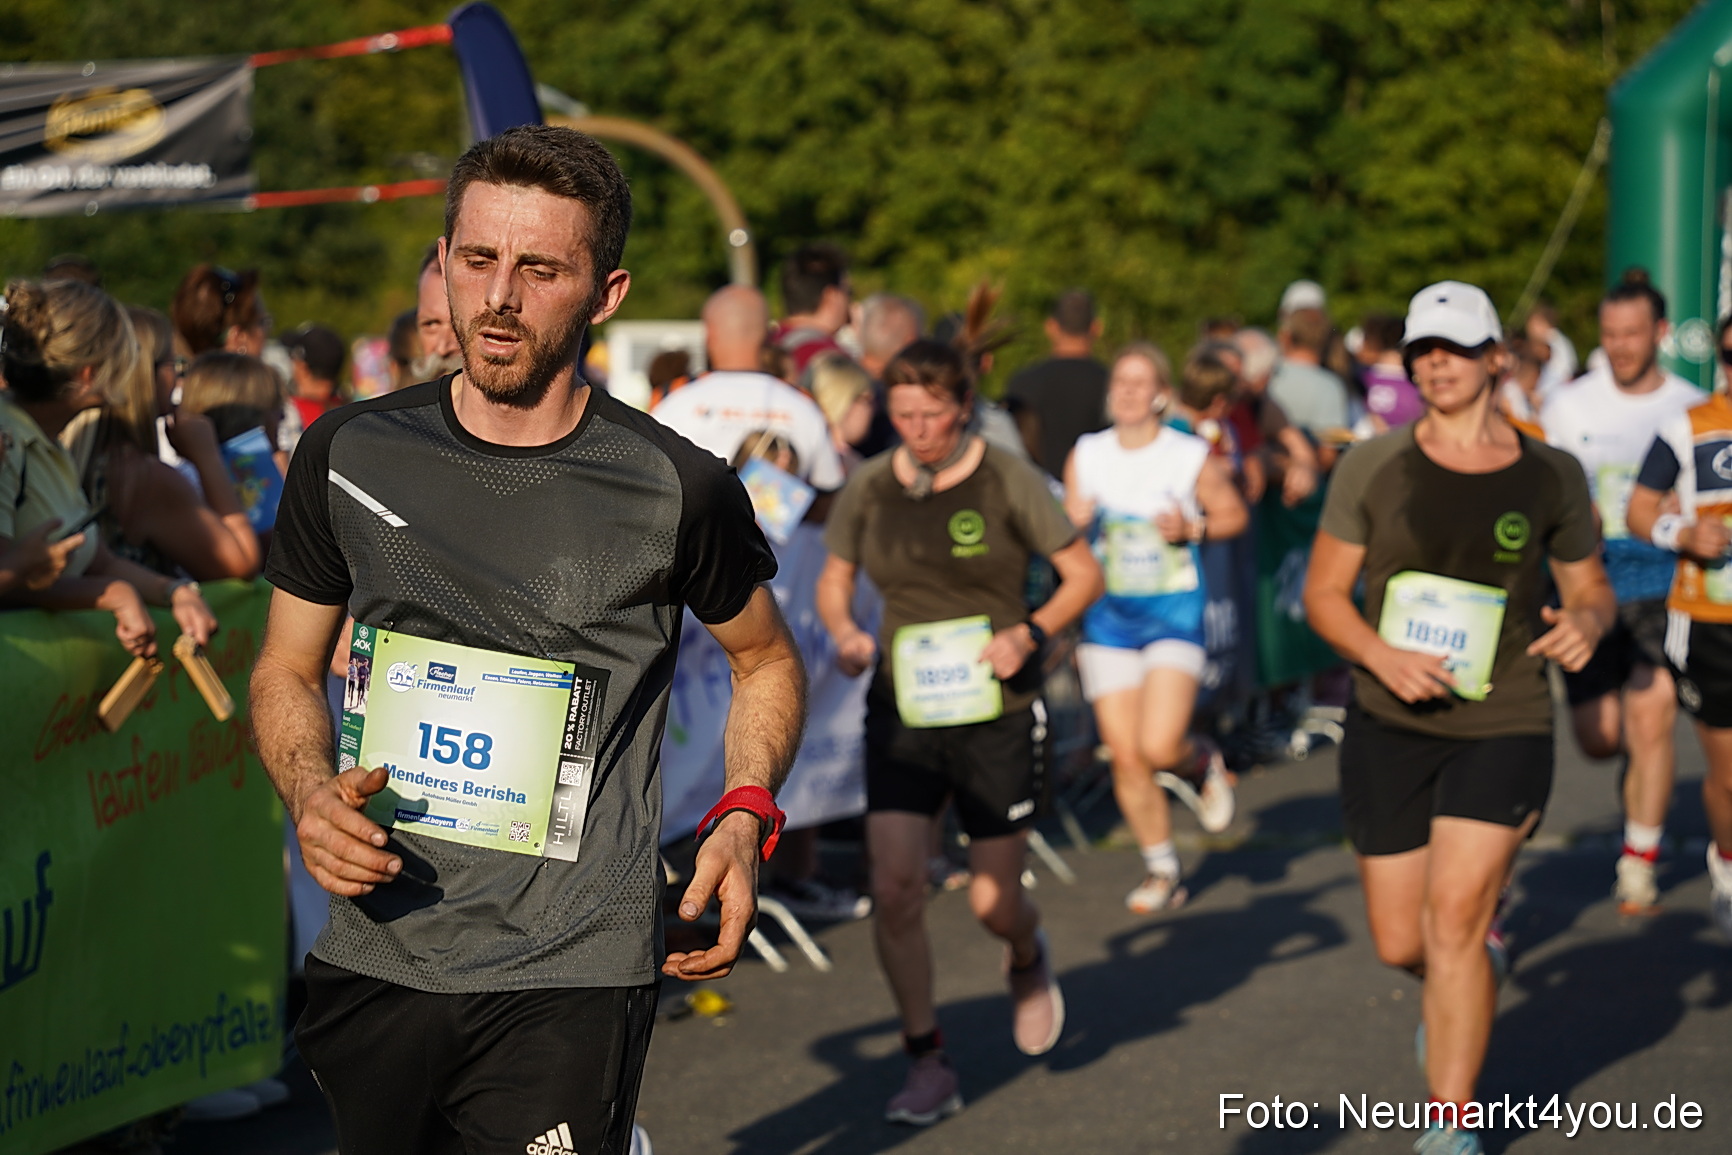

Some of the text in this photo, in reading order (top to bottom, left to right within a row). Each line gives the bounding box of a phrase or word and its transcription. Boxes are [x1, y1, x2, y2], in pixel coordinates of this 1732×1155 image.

[353, 638, 371, 652] AOK
[1406, 619, 1467, 651] 1898
[416, 679, 476, 695] Firmenlauf
[438, 692, 473, 702] neumarkt
[564, 676, 583, 750] 20 % RABATT
[575, 713, 587, 751] FACTORY
[581, 679, 592, 712] OUTLET
[418, 721, 492, 770] 158
[383, 762, 526, 805] Menderes Berisha
[421, 791, 446, 802] Autohaus
[445, 796, 462, 805] Müller
[397, 811, 453, 827] firmenlauf.bayern
[553, 791, 572, 845] HILTL
